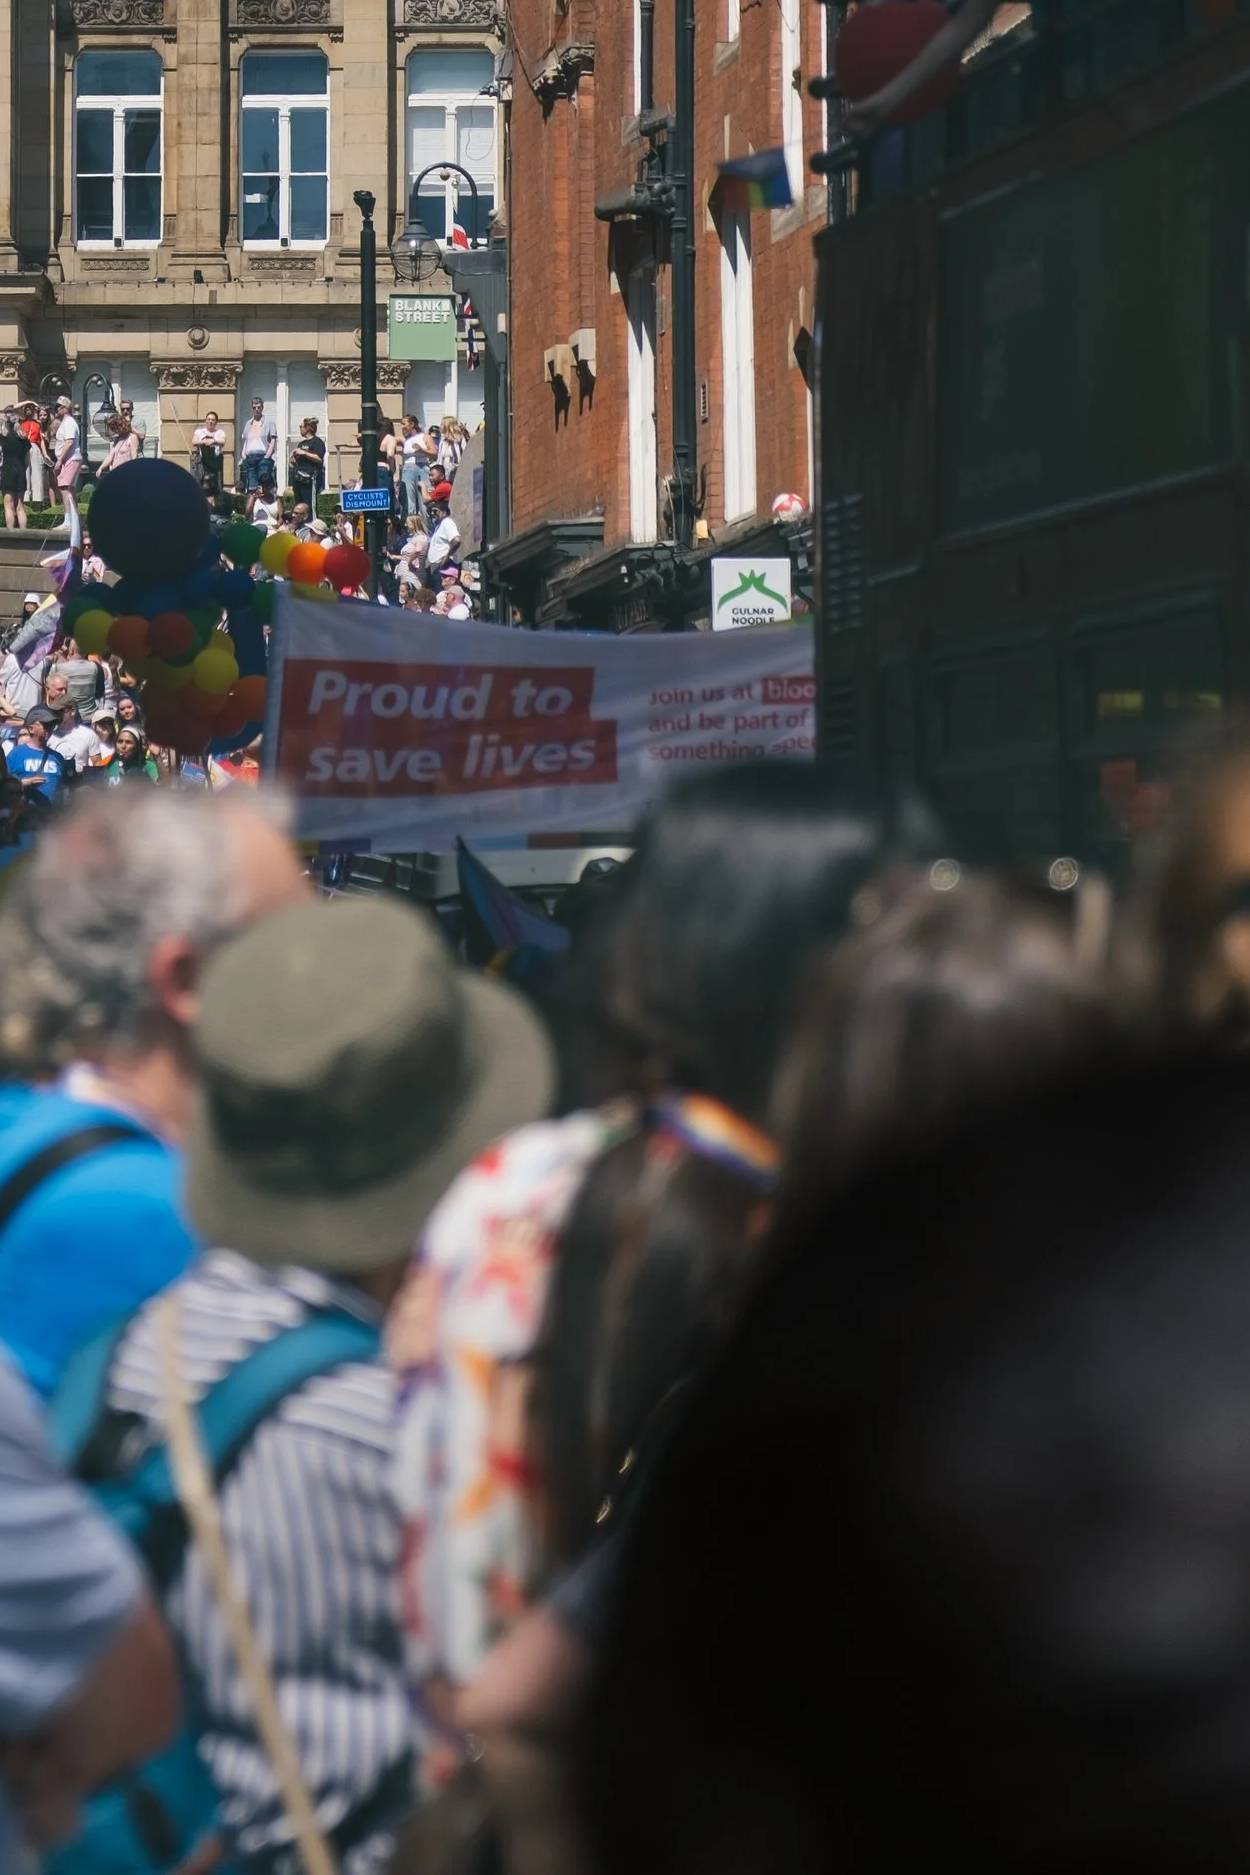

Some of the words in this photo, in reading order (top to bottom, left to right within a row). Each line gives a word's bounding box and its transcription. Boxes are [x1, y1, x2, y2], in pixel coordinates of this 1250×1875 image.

[395, 300, 441, 312] BLANK
[395, 311, 450, 324] STREET
[347, 492, 384, 501] CYCLISTS
[345, 499, 388, 509] DISMOUNT
[732, 607, 774, 615] GULNAR
[307, 670, 493, 720] Proud
[511, 679, 573, 718] to
[650, 687, 694, 705] Join
[702, 686, 725, 703] us
[732, 681, 755, 700] at
[649, 714, 691, 732] and
[699, 712, 726, 730] be
[734, 710, 779, 734] part
[786, 709, 809, 728] of
[305, 747, 442, 782] save
[462, 734, 597, 778] lives
[24, 759, 58, 774] NHS
